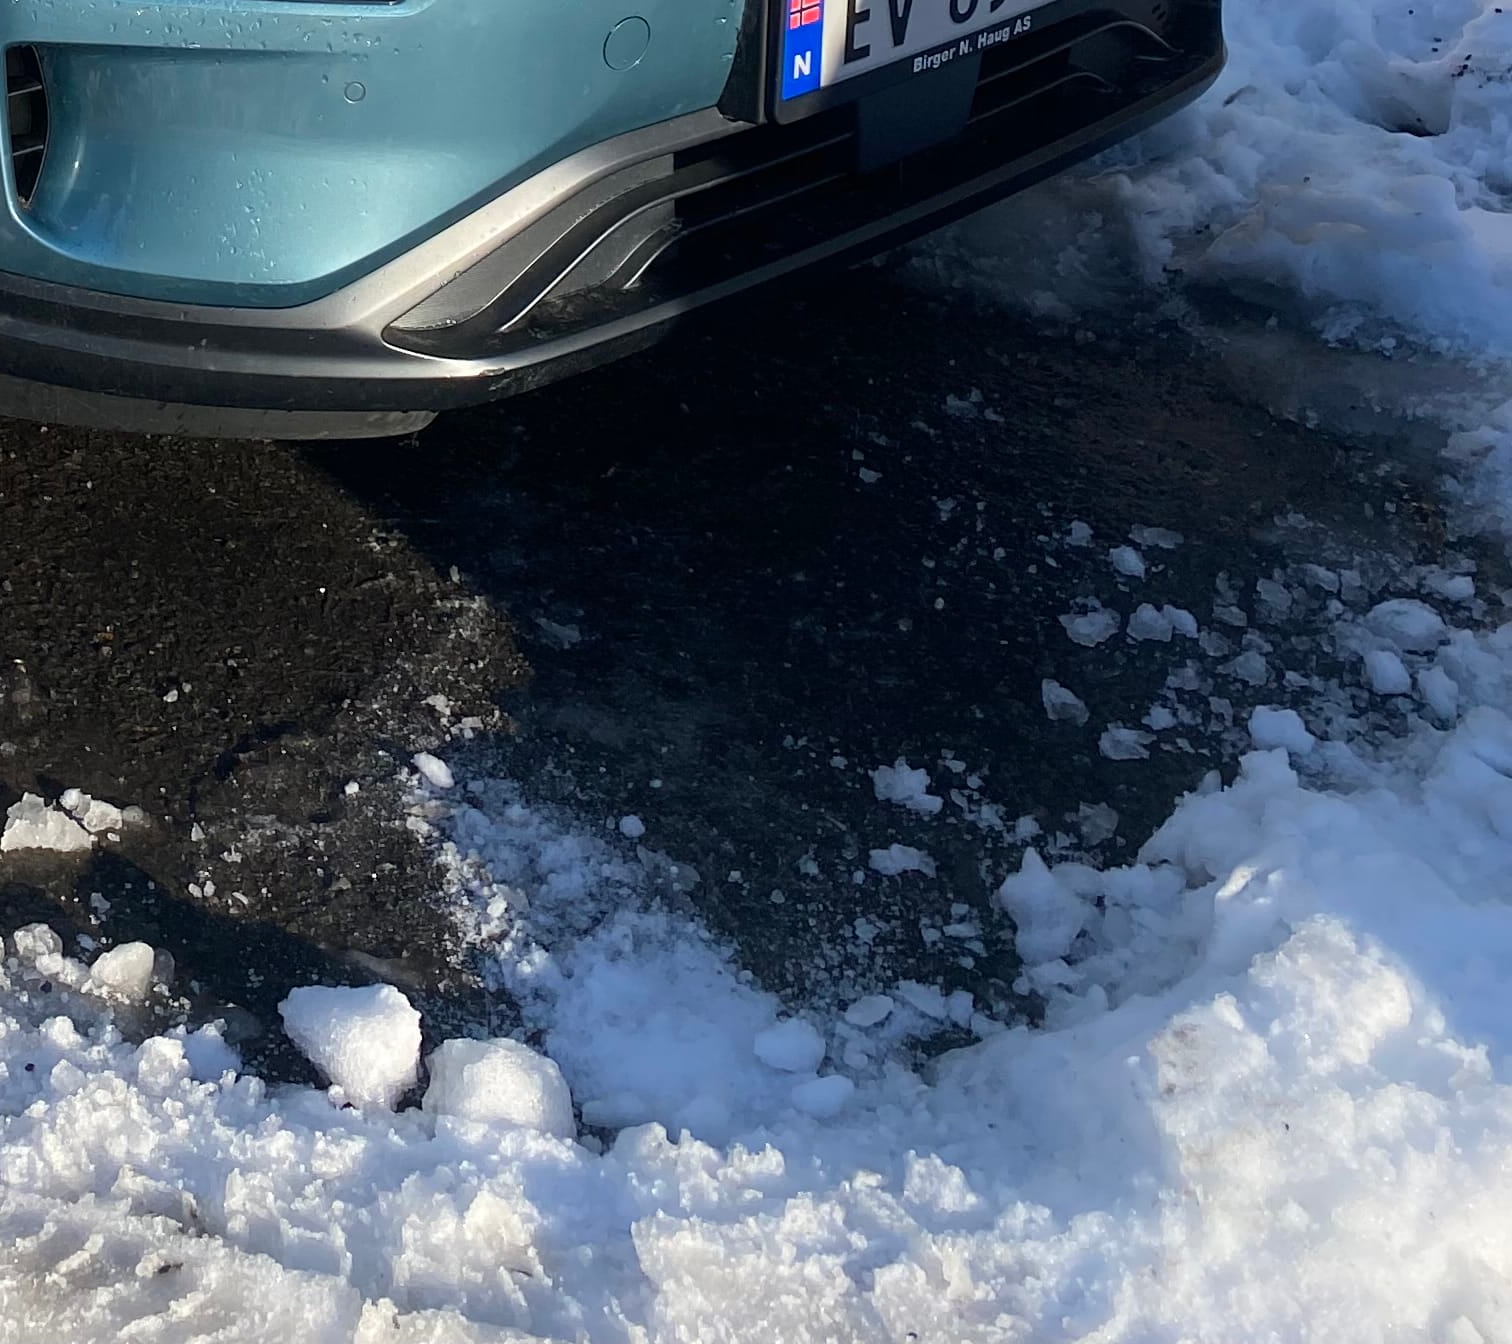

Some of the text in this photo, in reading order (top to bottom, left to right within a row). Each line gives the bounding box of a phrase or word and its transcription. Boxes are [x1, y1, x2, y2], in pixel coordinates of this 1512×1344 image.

[793, 51, 812, 79] N
[913, 15, 1031, 73] Birger N. Haug AS
